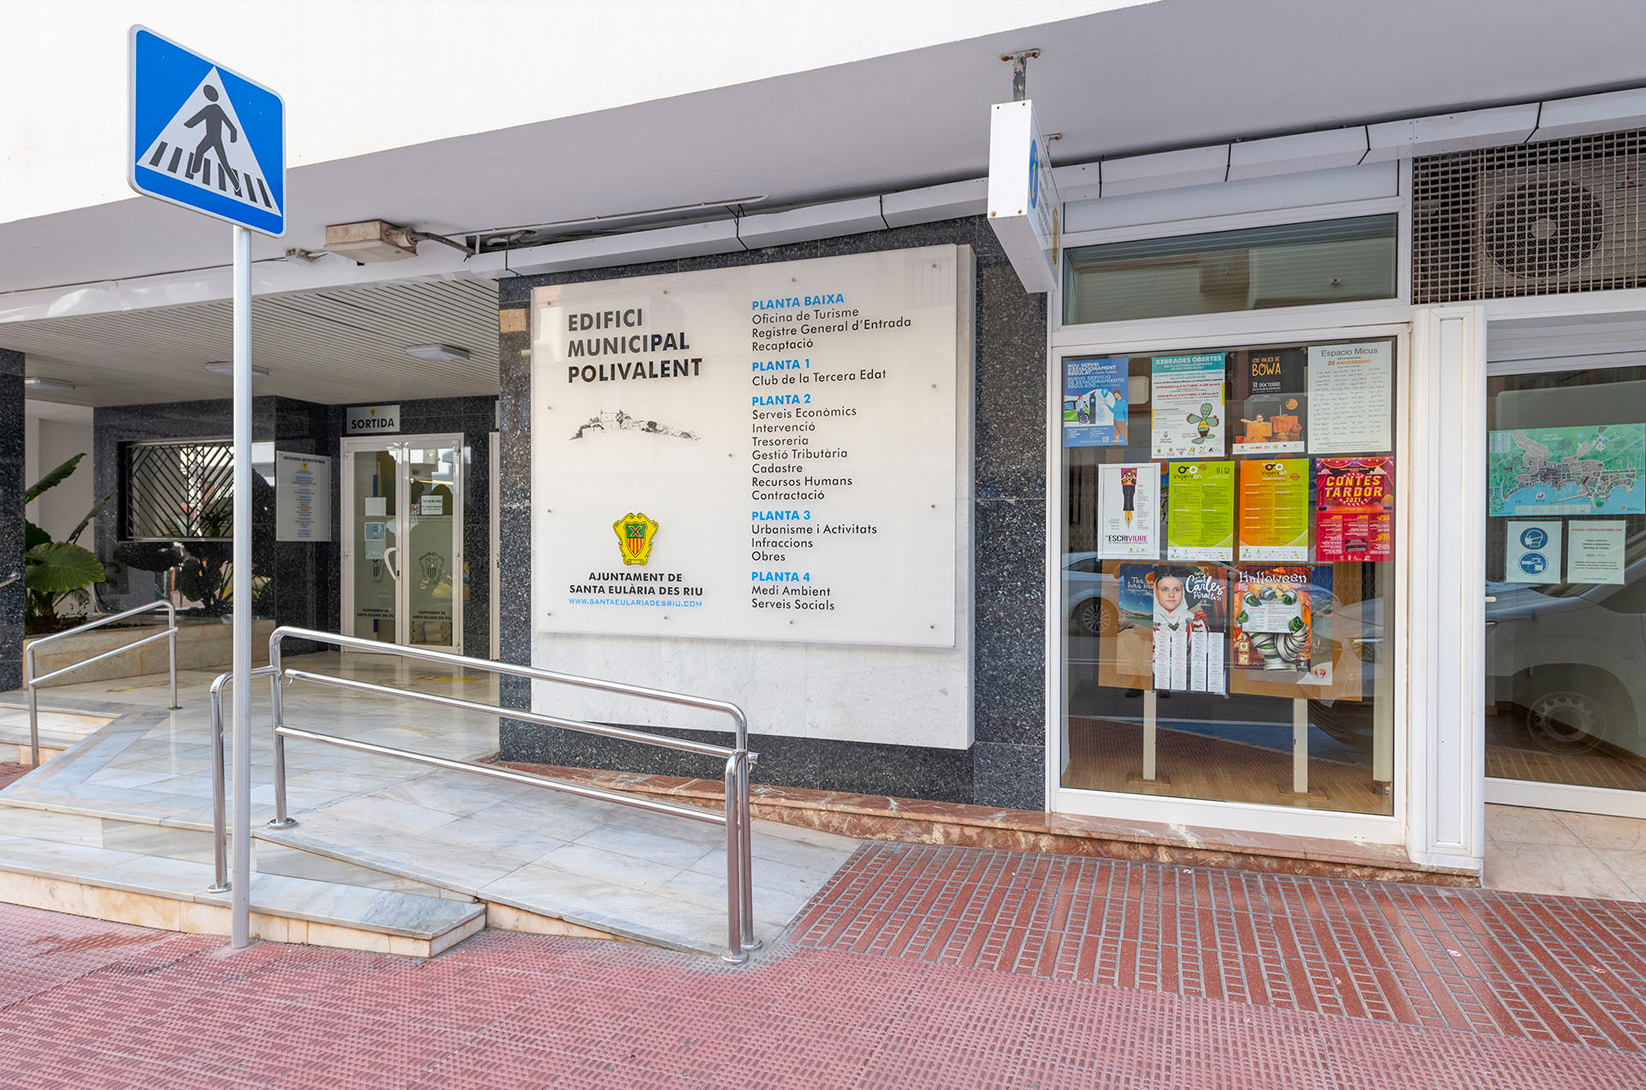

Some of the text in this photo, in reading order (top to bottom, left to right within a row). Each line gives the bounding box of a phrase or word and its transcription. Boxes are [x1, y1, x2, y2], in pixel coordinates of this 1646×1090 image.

[752, 293, 845, 311] PLANTA BAIXA
[568, 308, 643, 332] EDIFICI
[752, 308, 859, 325] Oficina de Turisme
[752, 316, 912, 340] Registre General d'Entrada
[567, 332, 690, 358] MUNICIPAL
[752, 338, 814, 352] Recaptació
[1321, 347, 1378, 357] Espacio Micus
[752, 358, 811, 372] PLANTA 1
[1155, 355, 1222, 365] XERRADES OBERTES
[568, 358, 702, 384] POLIVALENT
[1252, 362, 1281, 377] BOWA
[752, 368, 887, 387] Club de la Tercera Edat
[752, 393, 812, 406] PLANTA 2
[752, 406, 857, 420] Serveis Econòmics
[351, 418, 395, 429] SORTIDA
[752, 421, 816, 433] Intervenció
[752, 436, 809, 447] Tresoreria
[752, 448, 848, 460] Gestió Tributària
[752, 463, 803, 474] Cadastre
[752, 476, 853, 487] Recursos Humans
[1326, 475, 1381, 486] CONTES
[752, 490, 825, 500] Contractació
[1325, 486, 1383, 497] TARDOR
[752, 510, 811, 521] PLANTA 3
[752, 524, 877, 534] Urbanisme i Activitats
[752, 538, 814, 548] Infraccions
[752, 551, 786, 561] Obres
[589, 572, 683, 582] AJUNTAMENT DE
[751, 571, 811, 582] PLANTA 4
[1130, 576, 1144, 584] The
[1239, 570, 1307, 584] Halloween
[569, 583, 703, 596] SANTA EULÀRIA DES RIU
[751, 585, 831, 596] Medi Ambient
[1186, 575, 1225, 595] Carles
[568, 598, 703, 607] WWW.SANTAEULARIADESRIU.COM
[751, 598, 835, 611] Serveis Socials
